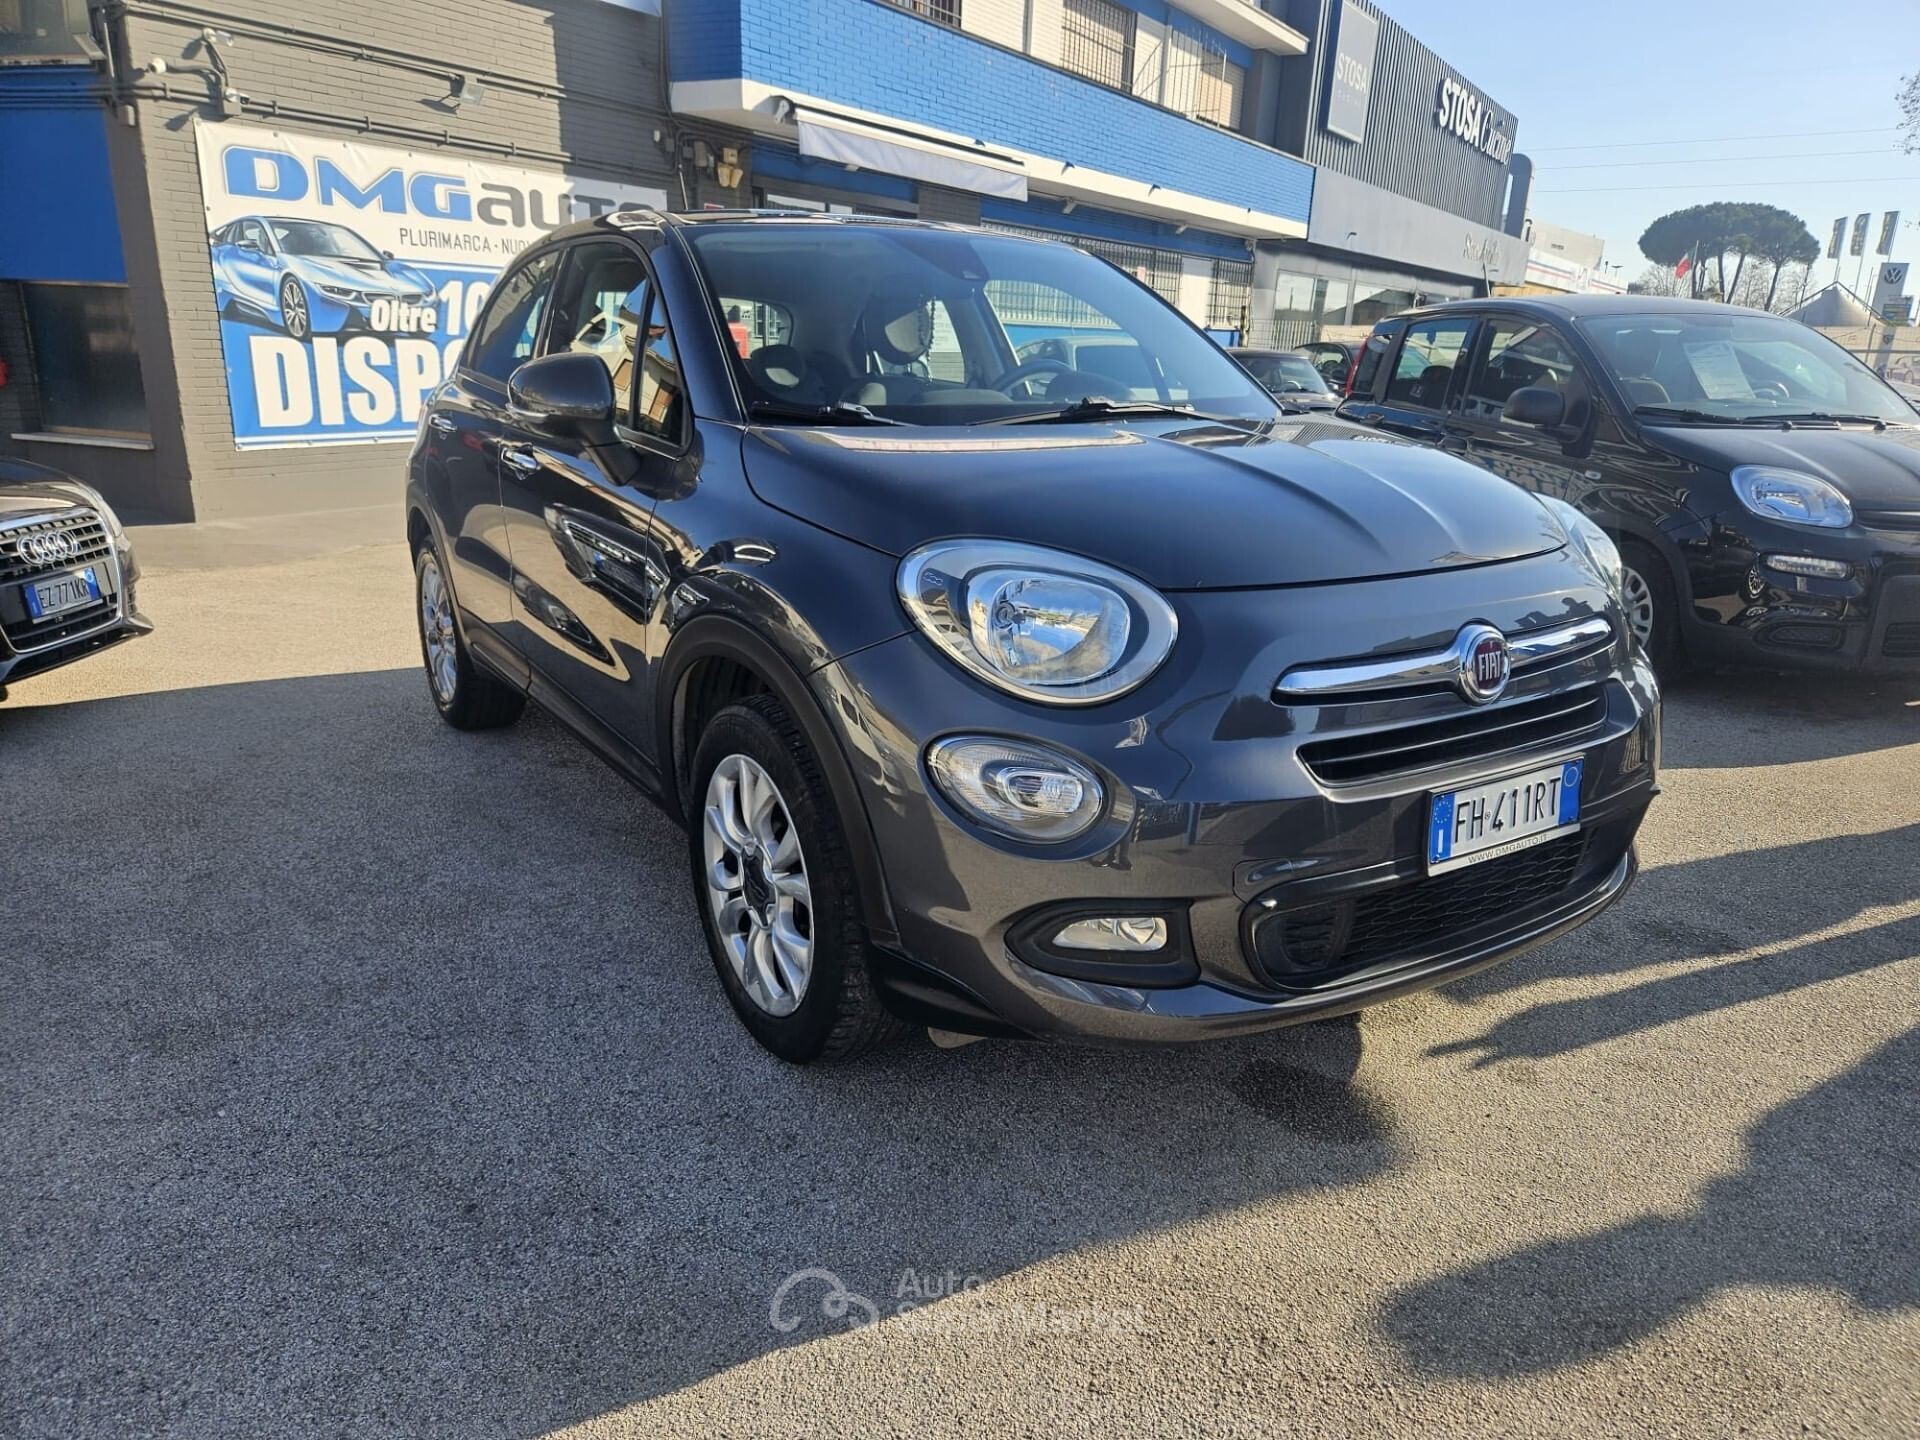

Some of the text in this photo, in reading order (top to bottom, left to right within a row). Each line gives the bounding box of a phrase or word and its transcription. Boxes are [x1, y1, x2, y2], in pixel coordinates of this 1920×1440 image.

[1336, 53, 1368, 94] STOSA
[1438, 77, 1483, 147] STOSA
[400, 227, 491, 253] PLURIMARCA
[370, 299, 438, 332] Oltre
[1478, 651, 1502, 681] FIAT
